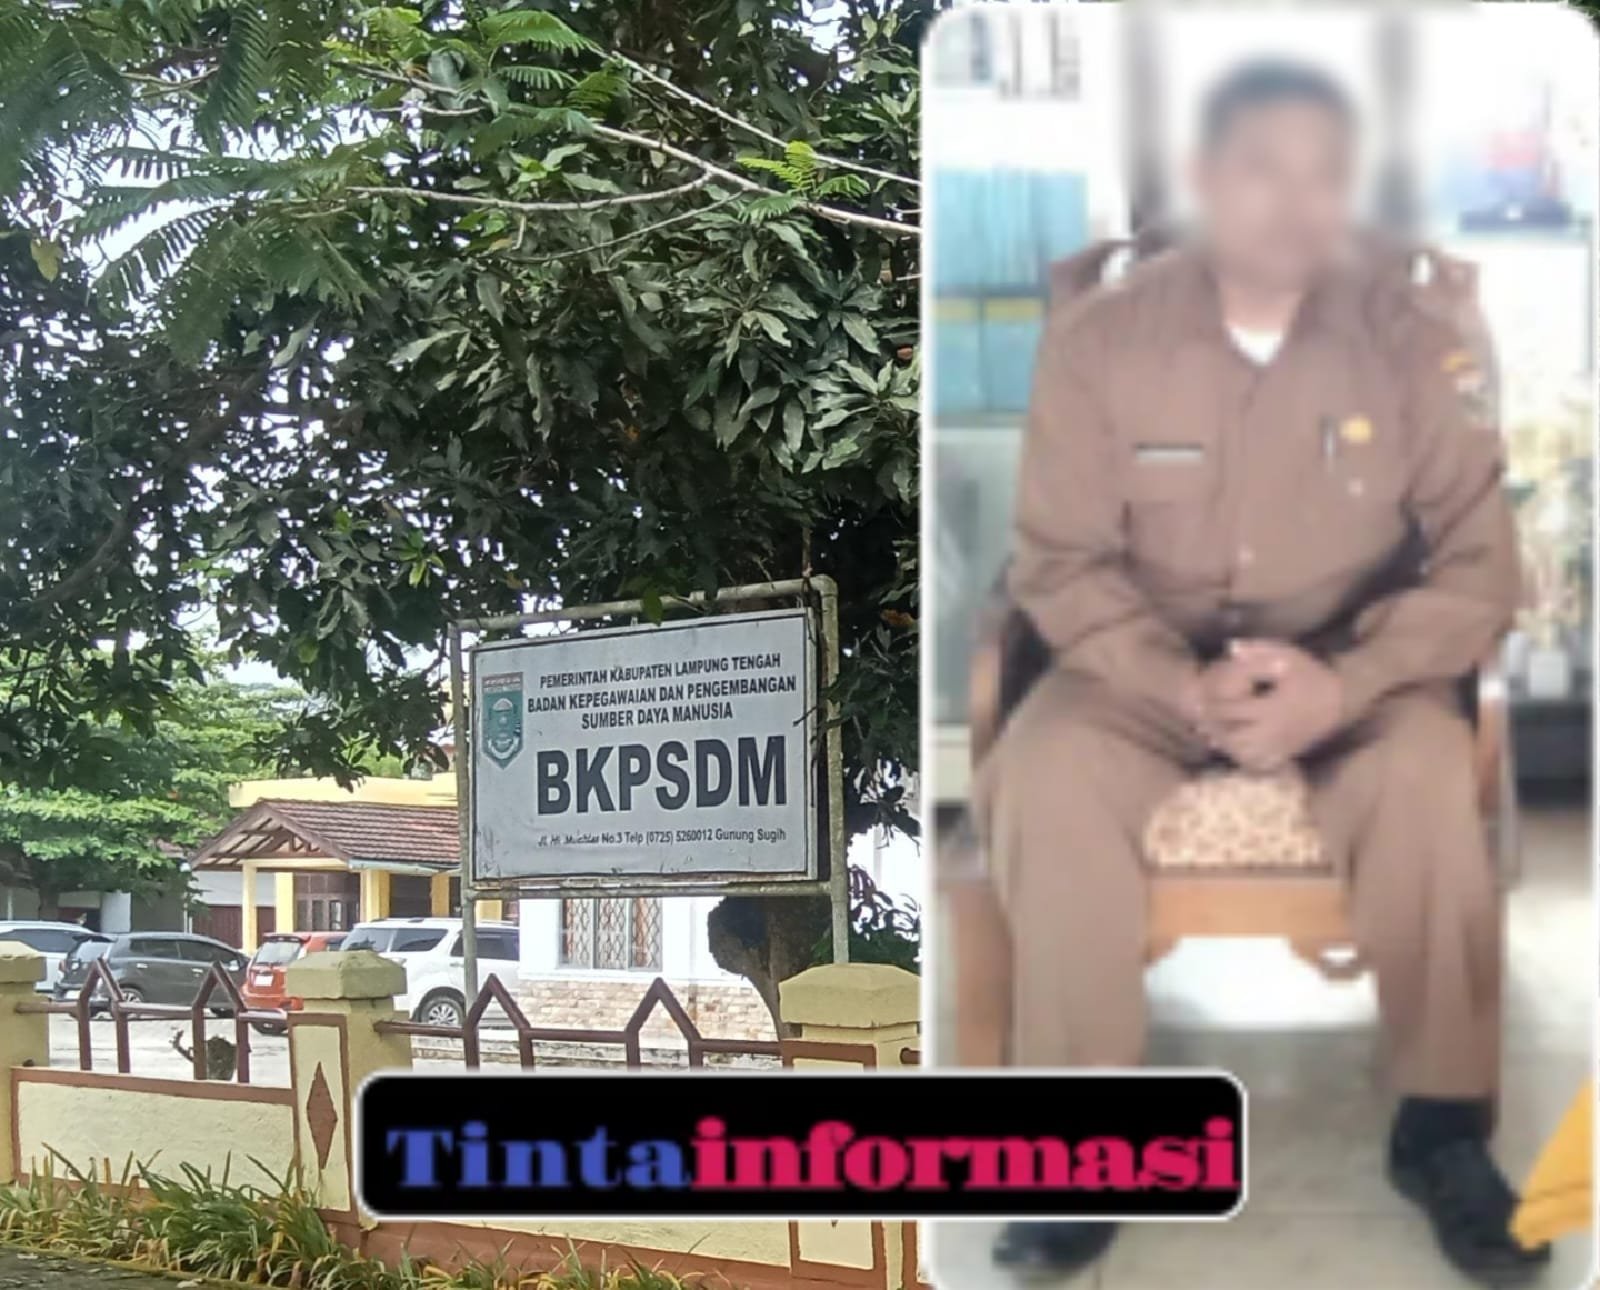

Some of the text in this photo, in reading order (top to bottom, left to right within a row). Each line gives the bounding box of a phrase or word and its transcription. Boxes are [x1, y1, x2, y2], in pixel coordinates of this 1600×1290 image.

[540, 669, 608, 689] PEMERINTAH
[610, 663, 672, 682] KABUPATEN
[675, 657, 729, 677] LAMPUNG
[731, 653, 781, 671] TENGAH
[528, 675, 796, 713] BADAN KEPEGAWAIAN DAN PENGEMBANGAN
[581, 701, 733, 730] SUMBER DAYA MANUSIA
[537, 735, 788, 816] BKPSDM
[624, 831, 644, 846] Telp
[645, 829, 674, 846] (0725)
[676, 828, 713, 842] 5260012
[715, 827, 754, 844] Gunung
[757, 827, 787, 843] Sugih
